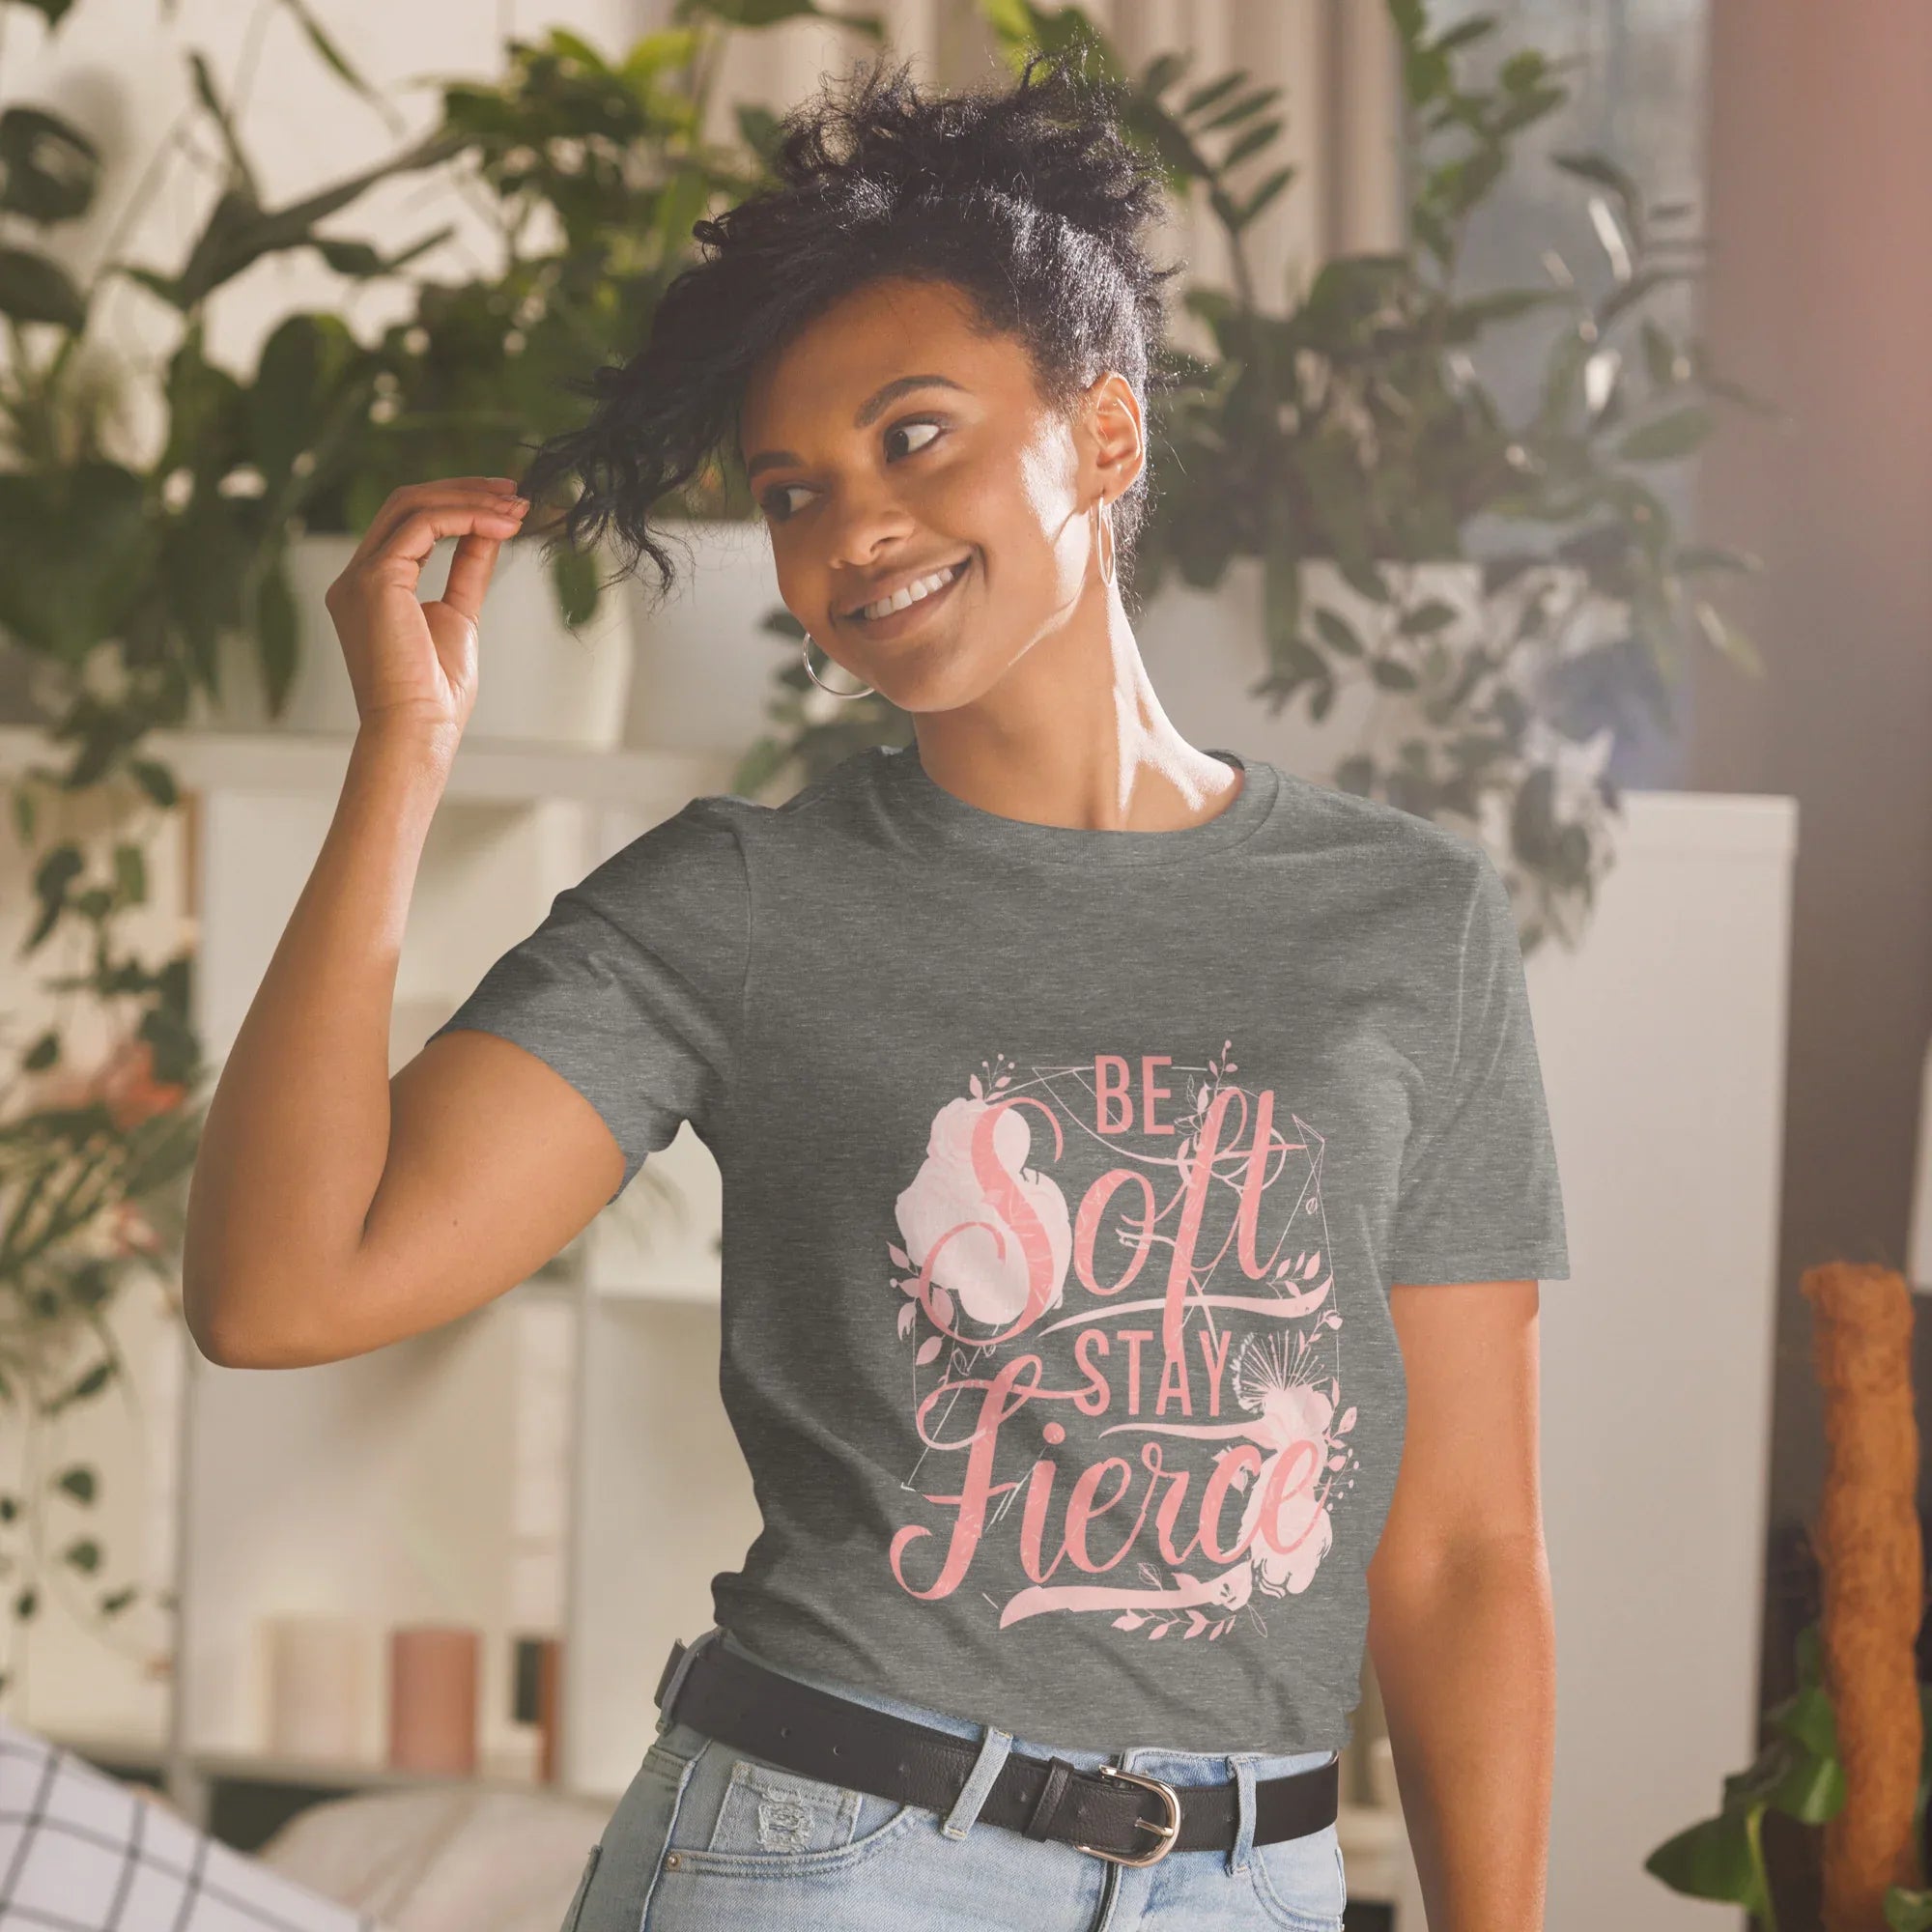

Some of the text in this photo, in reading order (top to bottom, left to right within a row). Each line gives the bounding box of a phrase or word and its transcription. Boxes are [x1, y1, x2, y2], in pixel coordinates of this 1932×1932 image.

[1094, 1054, 1176, 1135] BE
[918, 1087, 1307, 1349] Soft
[1074, 1328, 1232, 1417] STAY
[890, 1353, 1332, 1601] Fierce
